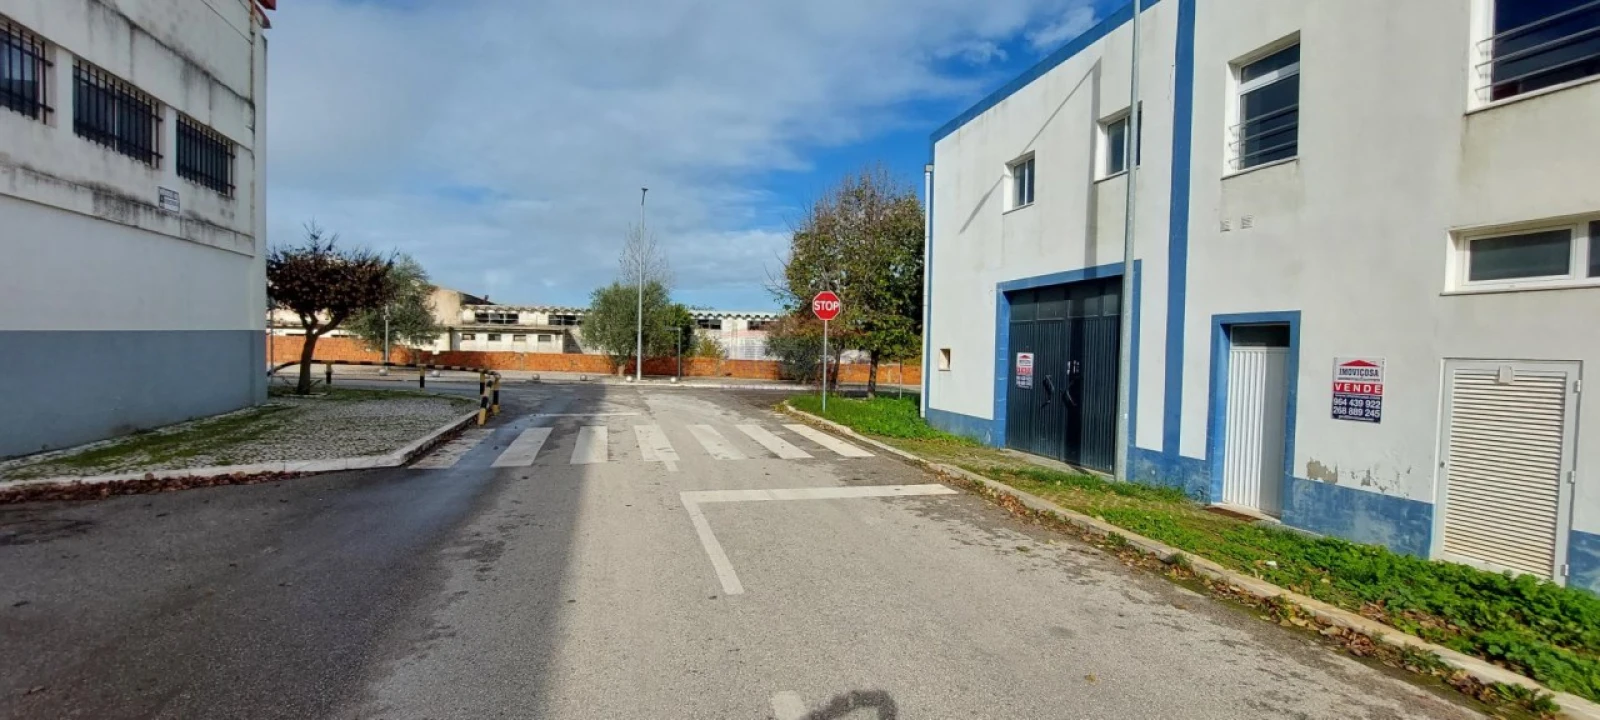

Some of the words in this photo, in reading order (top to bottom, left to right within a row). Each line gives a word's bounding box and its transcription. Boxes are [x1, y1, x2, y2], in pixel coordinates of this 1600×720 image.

[814, 301, 840, 310] STOP
[1334, 383, 1382, 393] VENDE
[1349, 399, 1364, 407] 439
[1365, 400, 1381, 409] 922
[1365, 408, 1381, 418] 245
